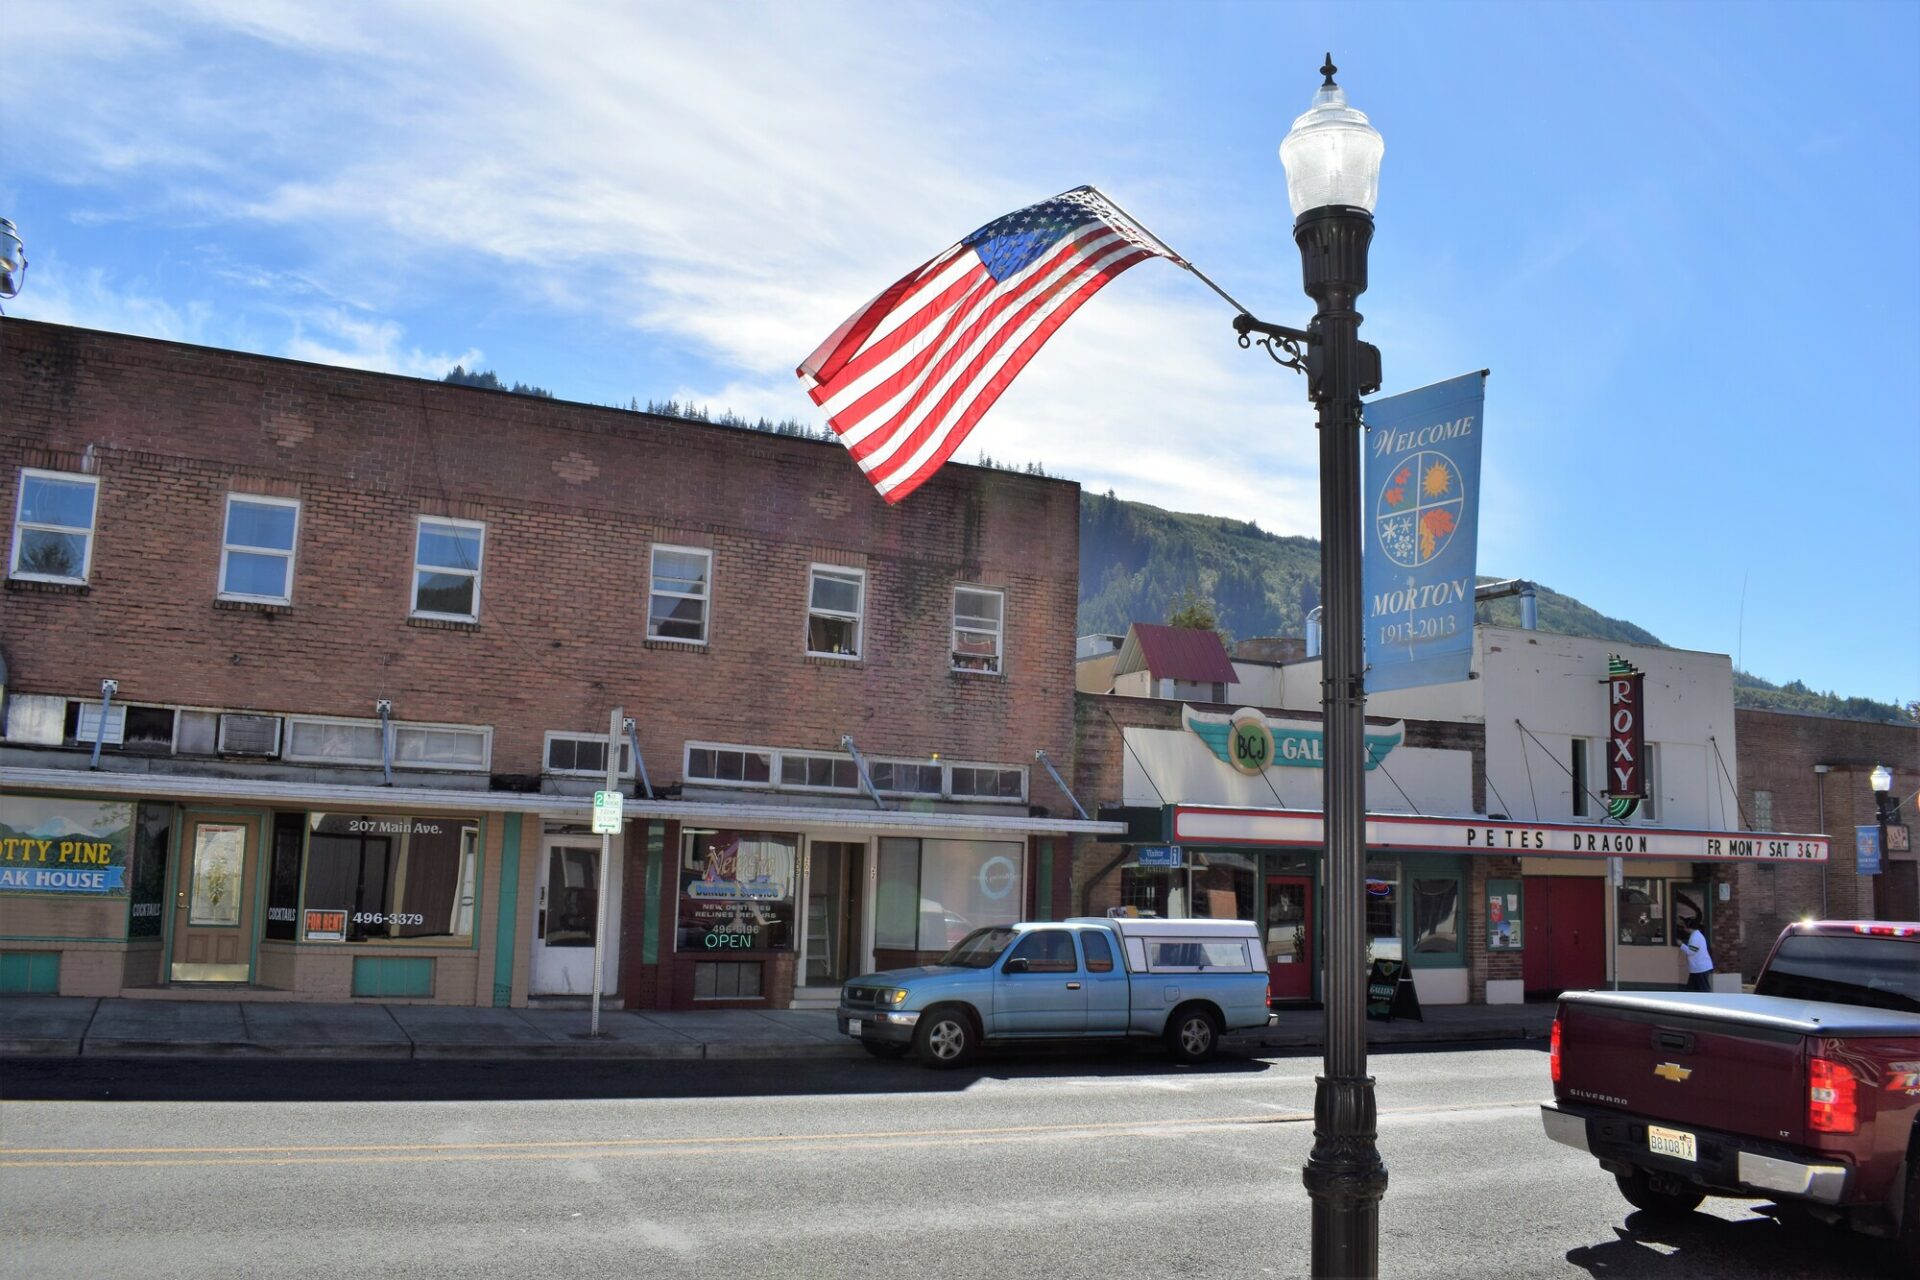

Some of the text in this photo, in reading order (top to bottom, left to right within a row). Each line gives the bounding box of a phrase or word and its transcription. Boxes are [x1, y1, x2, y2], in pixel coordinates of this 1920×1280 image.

[1371, 578, 1468, 617] MORTON
[1380, 614, 1456, 645] 1913-2013
[1612, 680, 1634, 791] ROXY
[596, 794, 603, 806] 2
[349, 820, 443, 834] 207 Main Ave.
[1467, 828, 1647, 852] PETES DRAGON
[1708, 839, 1721, 855] FR
[1729, 839, 1752, 856] MON
[1769, 841, 1789, 857] SAT
[0, 838, 112, 865] TTY PINE
[35, 871, 105, 889] HOUSE
[307, 912, 344, 931] FOR RENT
[353, 912, 423, 925] 496-3379
[704, 934, 751, 948] OPEN
[1570, 1088, 1628, 1105] SILVERADO
